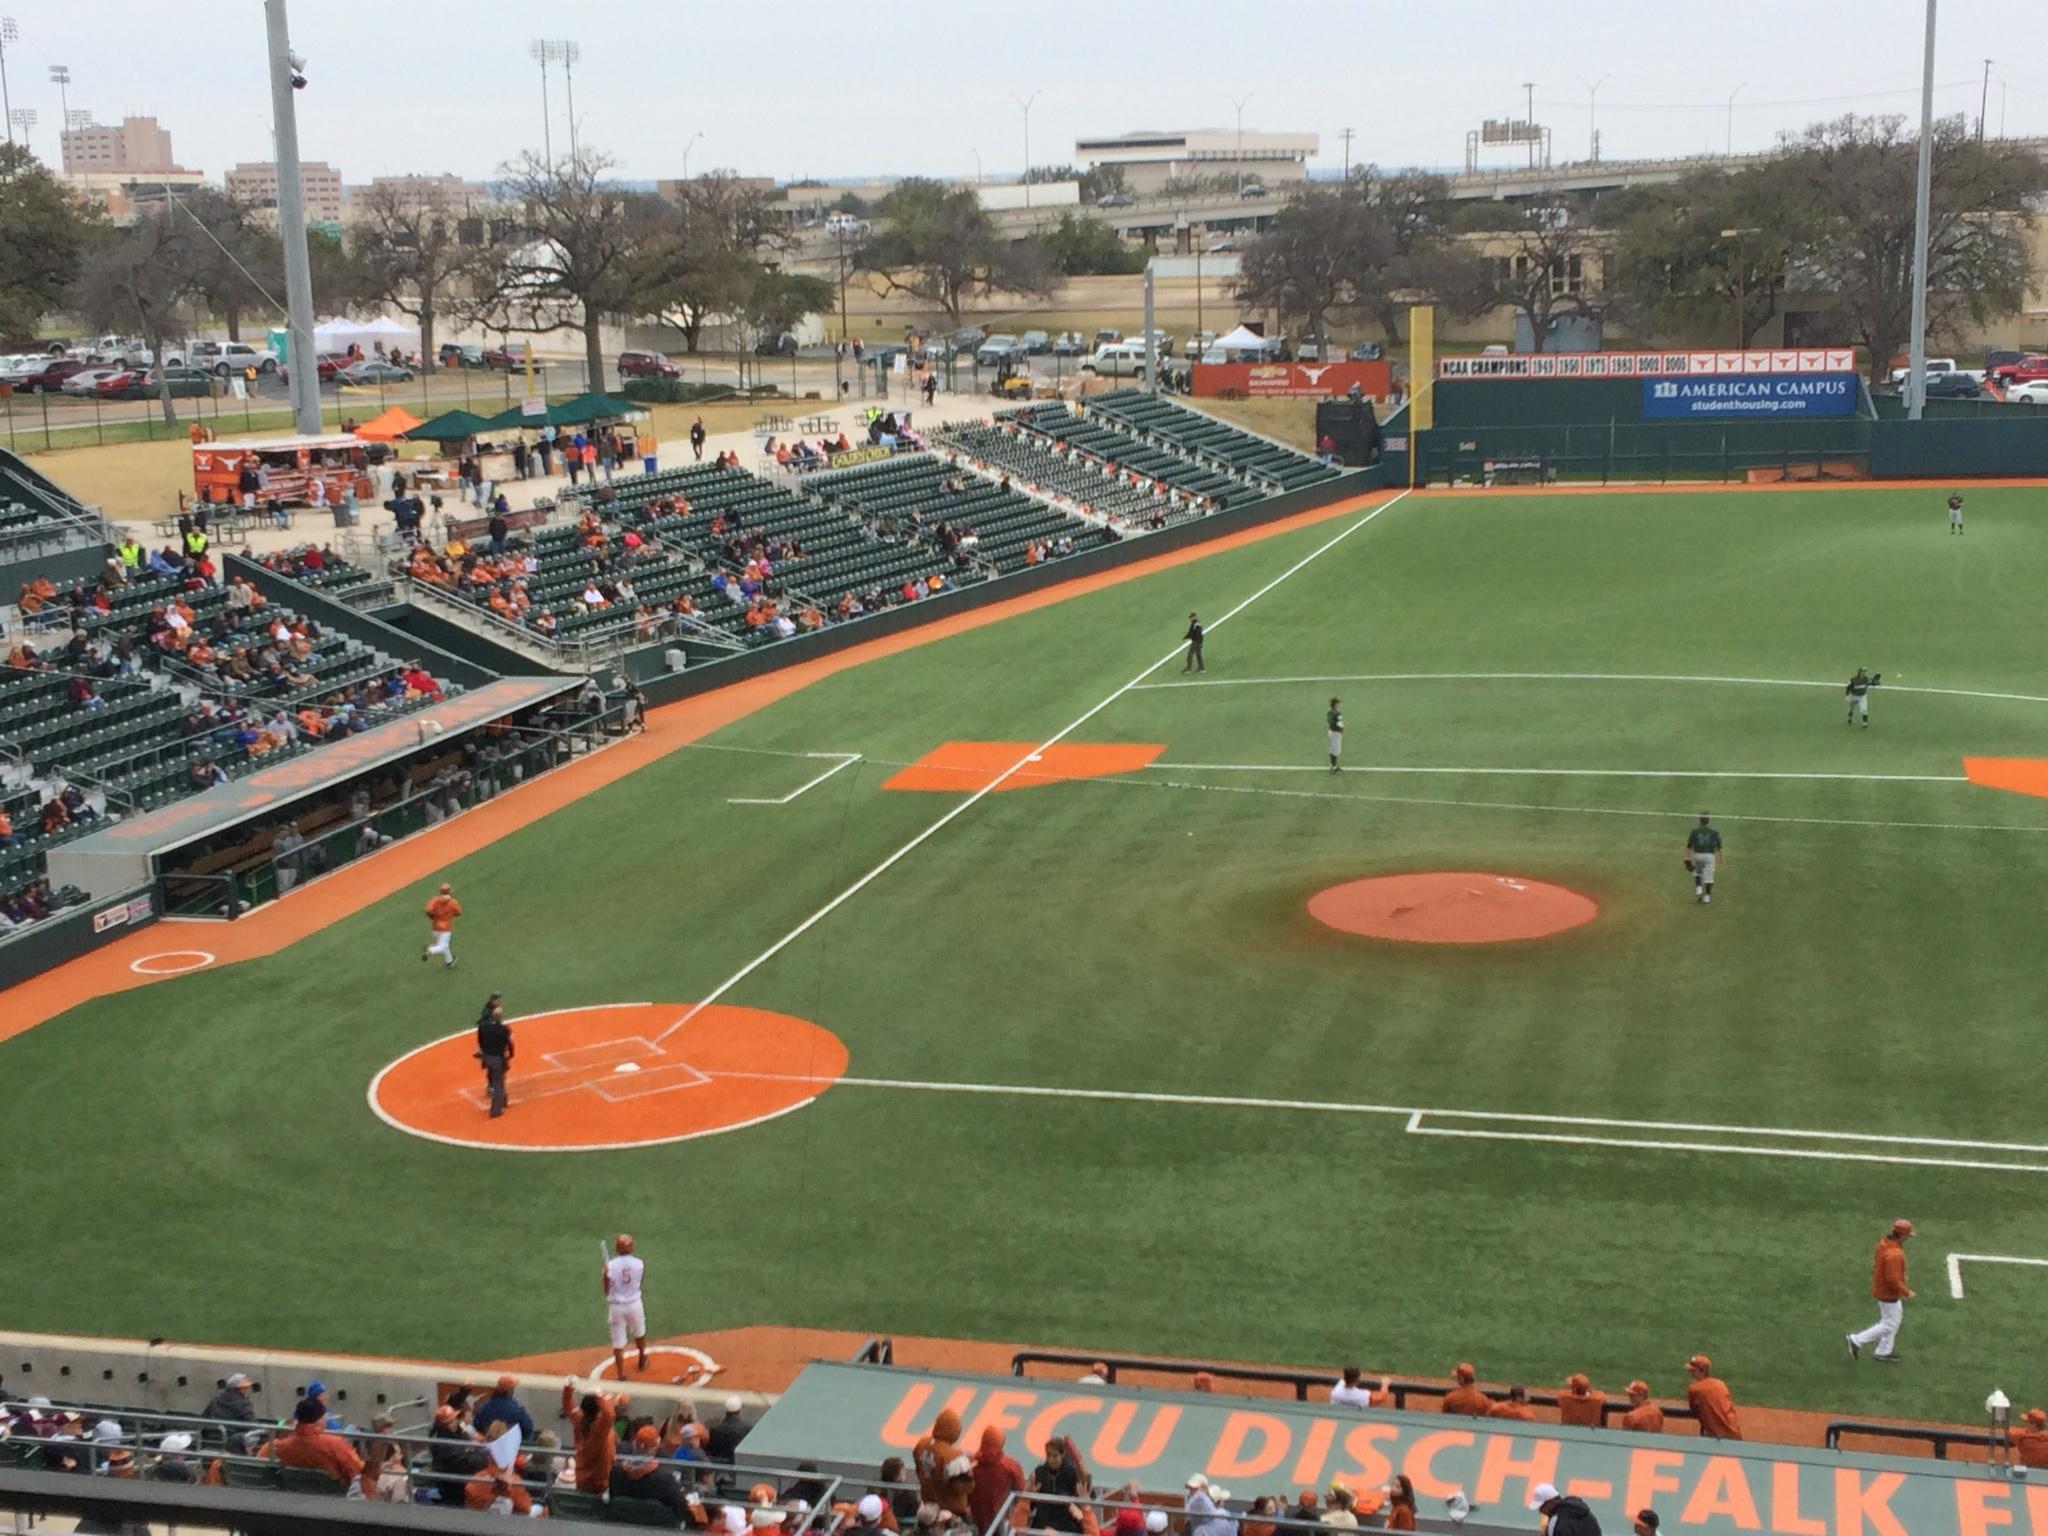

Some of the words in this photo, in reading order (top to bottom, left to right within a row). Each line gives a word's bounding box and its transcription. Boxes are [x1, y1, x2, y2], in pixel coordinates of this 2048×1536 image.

[1443, 360, 1468, 375] NCAA
[1471, 359, 1528, 375] CHAMPIONS
[1638, 356, 1660, 372] 2002
[1679, 382, 1771, 398] AMERICAN
[1776, 380, 1846, 395] CAMPUS
[1691, 399, 1807, 411] studenthousing.com
[880, 1382, 1184, 1469] UFCU
[1205, 1410, 1909, 1536] DISCH-FALK
